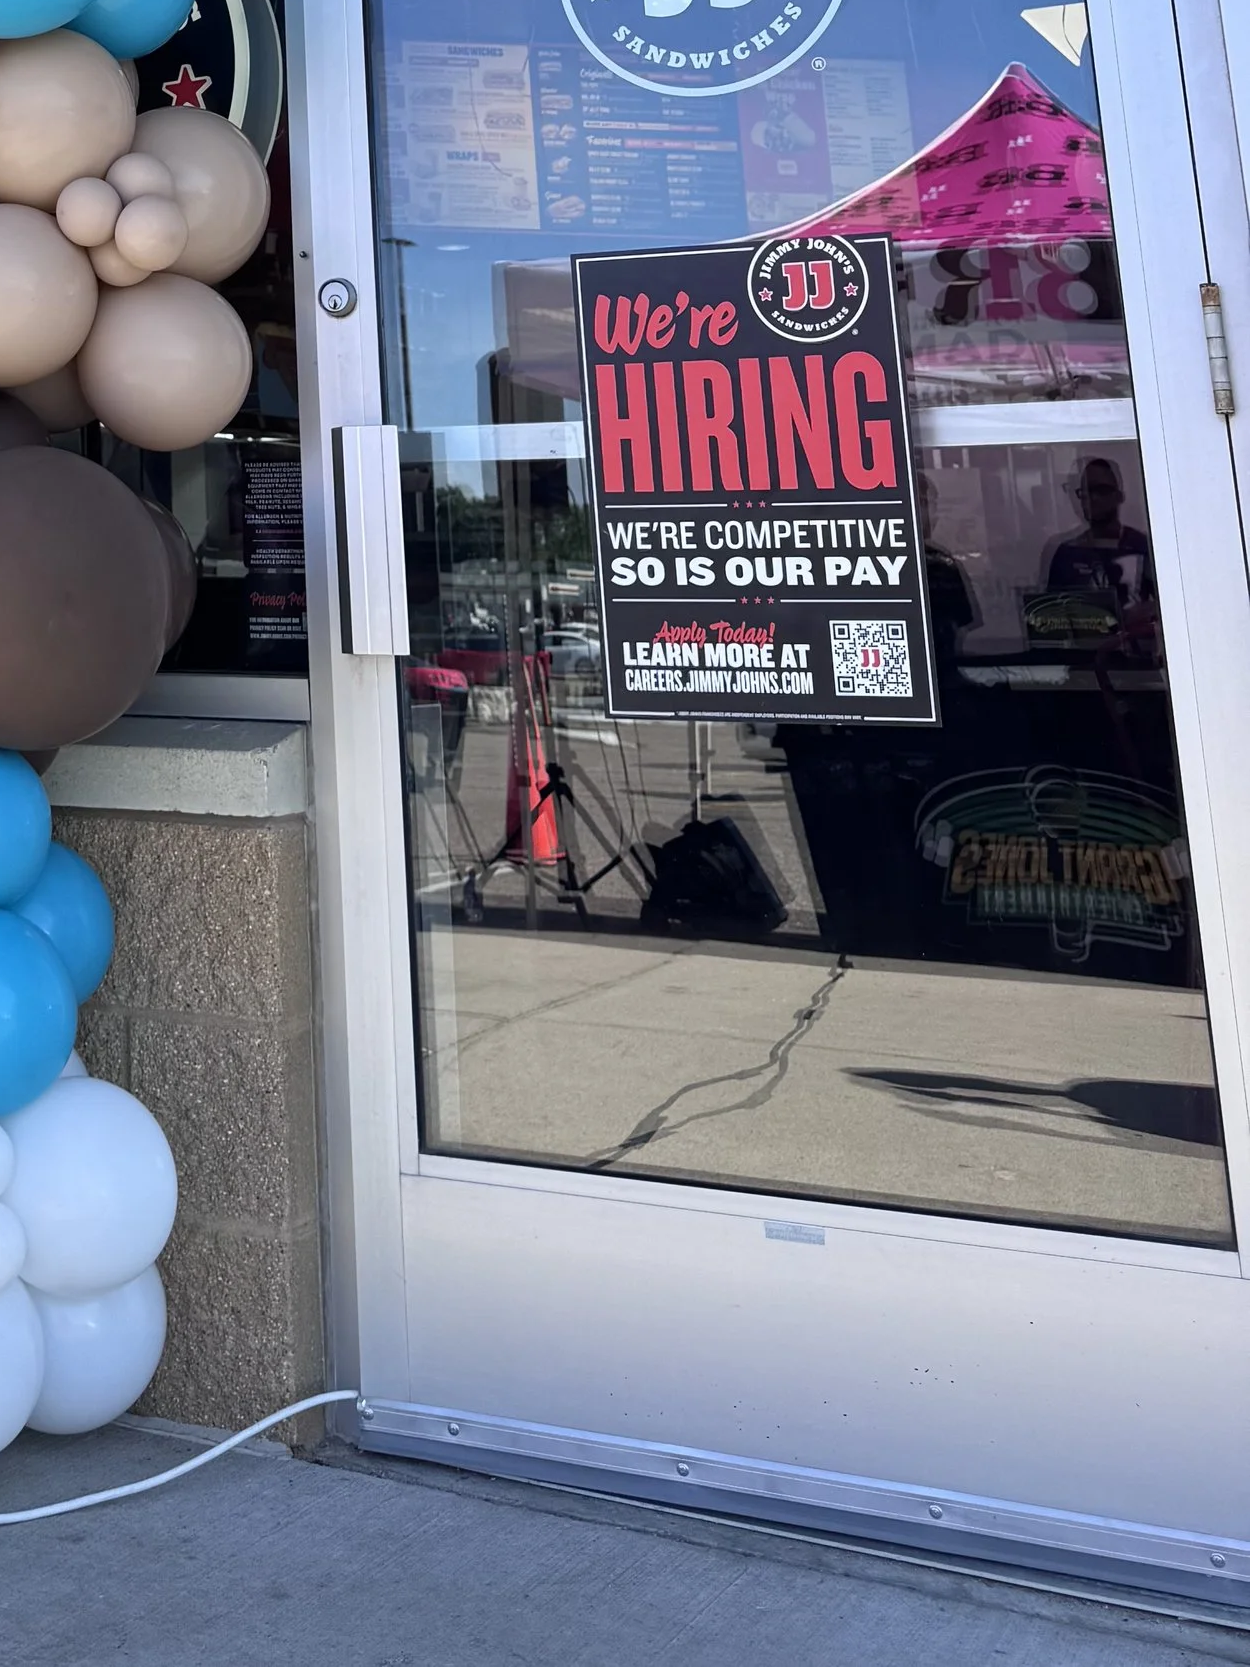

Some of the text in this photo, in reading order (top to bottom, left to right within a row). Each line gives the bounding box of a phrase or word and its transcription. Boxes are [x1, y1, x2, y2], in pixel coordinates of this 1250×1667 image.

[612, 0, 803, 69] SANDWICHES
[759, 238, 855, 280] JIMMY JOHN'S
[782, 260, 836, 311] JJ
[594, 290, 739, 356] We're
[771, 306, 849, 332] SANDWICHES
[595, 350, 898, 494] HIRING
[606, 518, 908, 550] WE'RE COMPETITIVE
[610, 555, 909, 586] SO IS OUR PAY
[287, 591, 306, 607] Pol
[653, 619, 776, 650] Apply Today!
[622, 641, 811, 669] LEARN MORE AT
[625, 668, 815, 695] CAREERS.JIMMYJOHNS.COM
